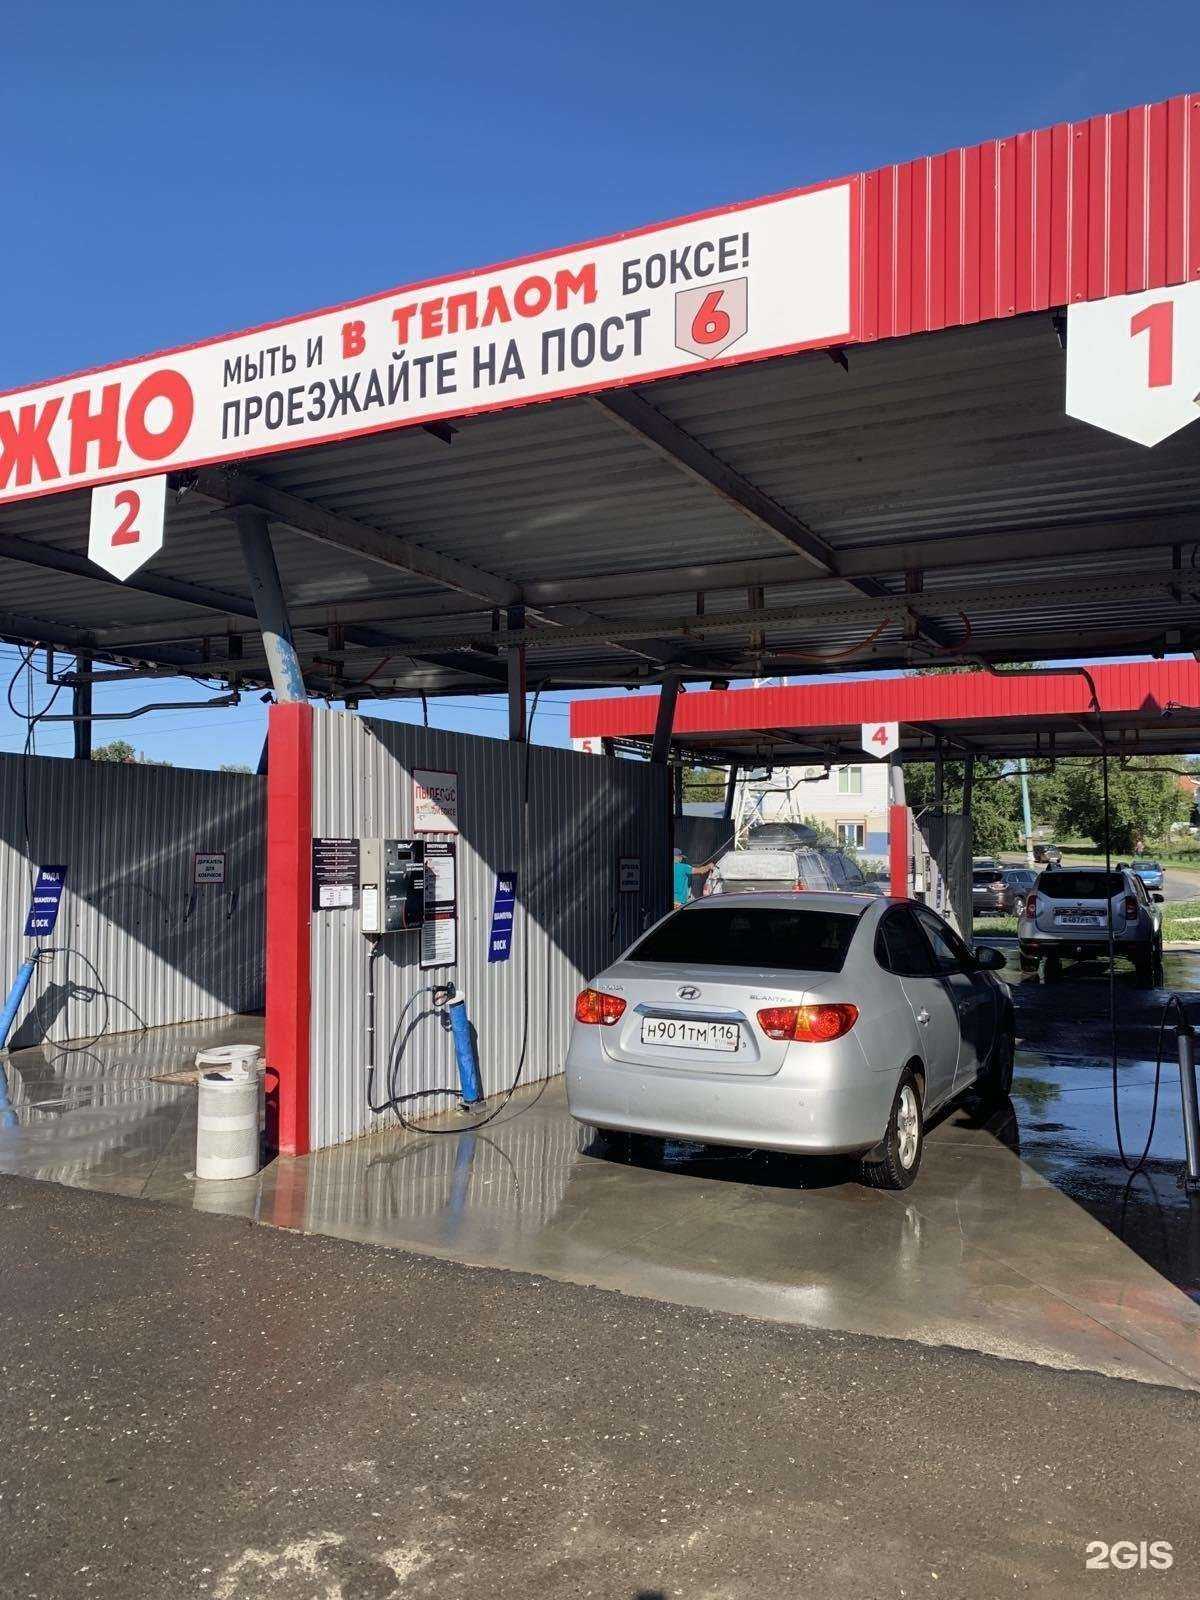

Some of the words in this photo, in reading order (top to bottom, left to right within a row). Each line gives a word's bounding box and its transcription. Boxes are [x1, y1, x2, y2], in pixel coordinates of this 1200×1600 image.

[223, 344, 297, 388] МЫТЬ
[306, 335, 323, 368] И
[341, 320, 366, 360] В
[392, 262, 597, 346] ТЕПЛОМ
[622, 232, 750, 296] БОКСЕ!
[1130, 300, 1174, 388] 1
[222, 349, 457, 440] ПРОЕЗЖАЙТЕ
[472, 338, 525, 389] НА
[541, 308, 651, 376] ПОСТ
[691, 290, 731, 345] 6
[110, 489, 141, 547] 2
[871, 725, 888, 746] 4
[582, 740, 593, 756] 5
[42, 872, 60, 881] ВОДА
[500, 881, 513, 893] ВОДА
[31, 919, 49, 928] ВОСК
[493, 939, 507, 951] ВОСК
